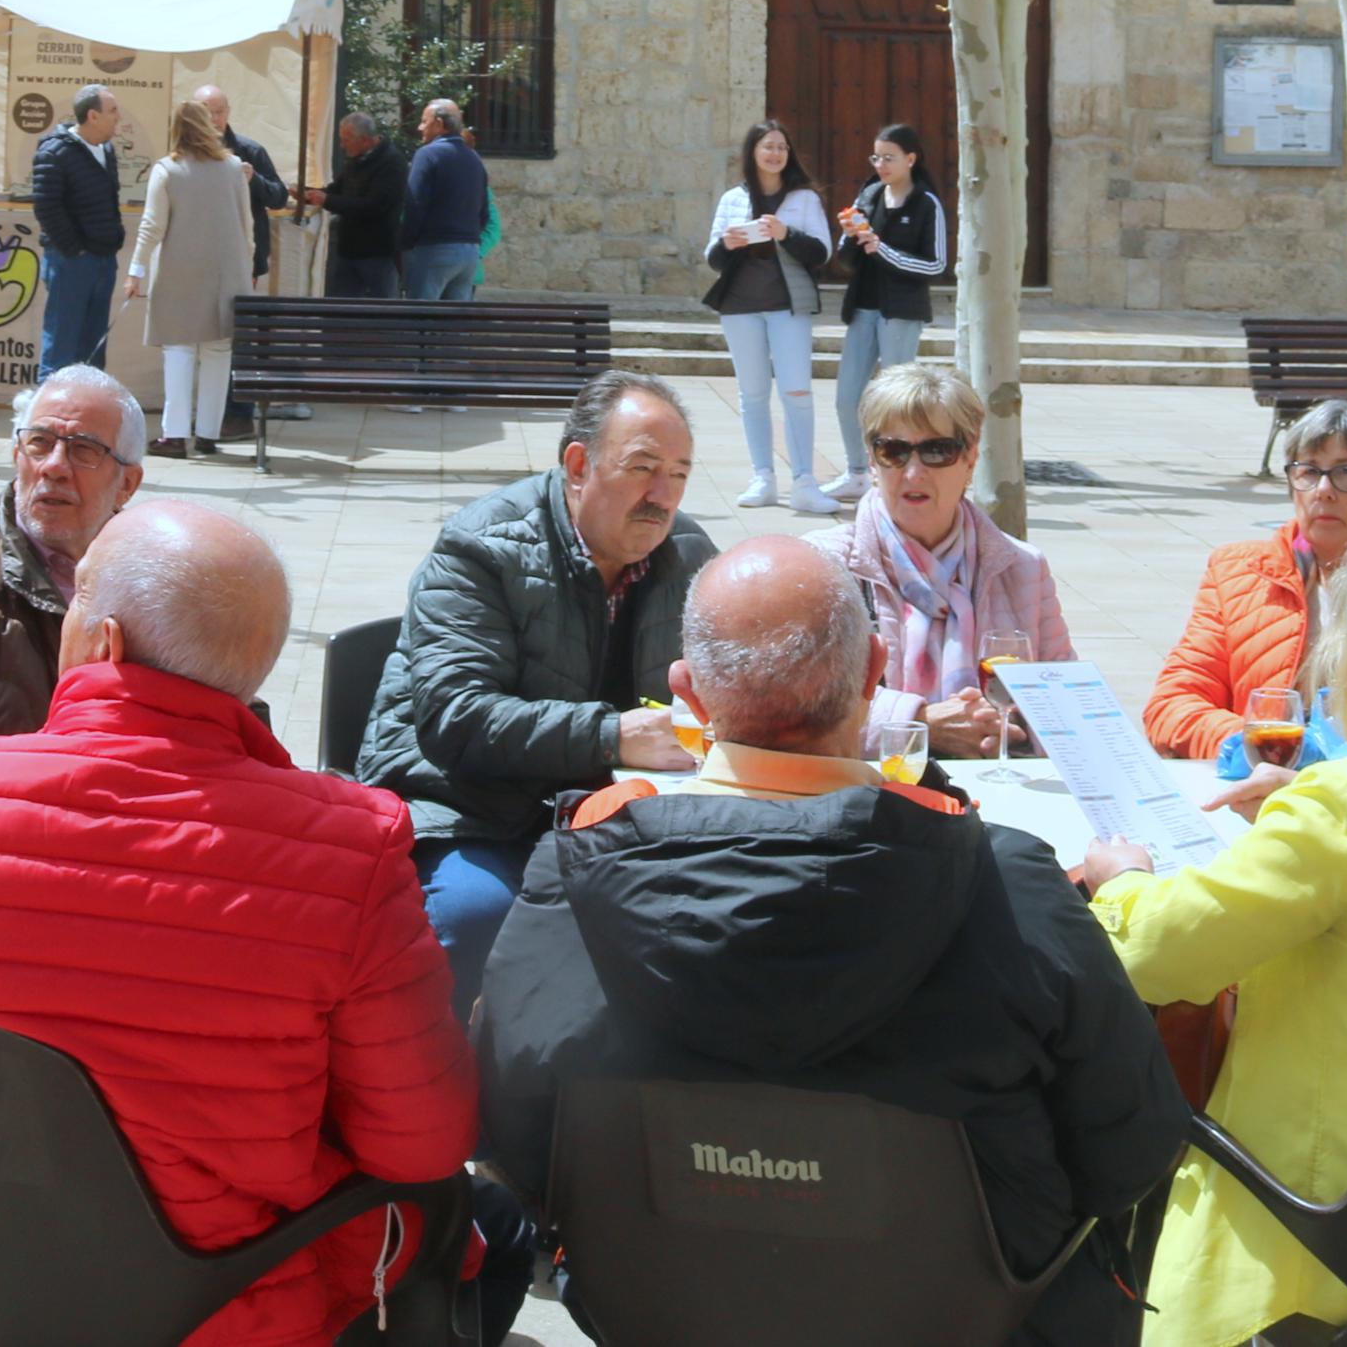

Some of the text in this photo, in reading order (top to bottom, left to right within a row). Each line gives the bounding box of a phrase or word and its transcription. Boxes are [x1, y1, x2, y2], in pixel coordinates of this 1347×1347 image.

[37, 41, 84, 54] CERRATO
[36, 54, 84, 66] PALENTINO
[690, 1141, 823, 1182] Mahou
